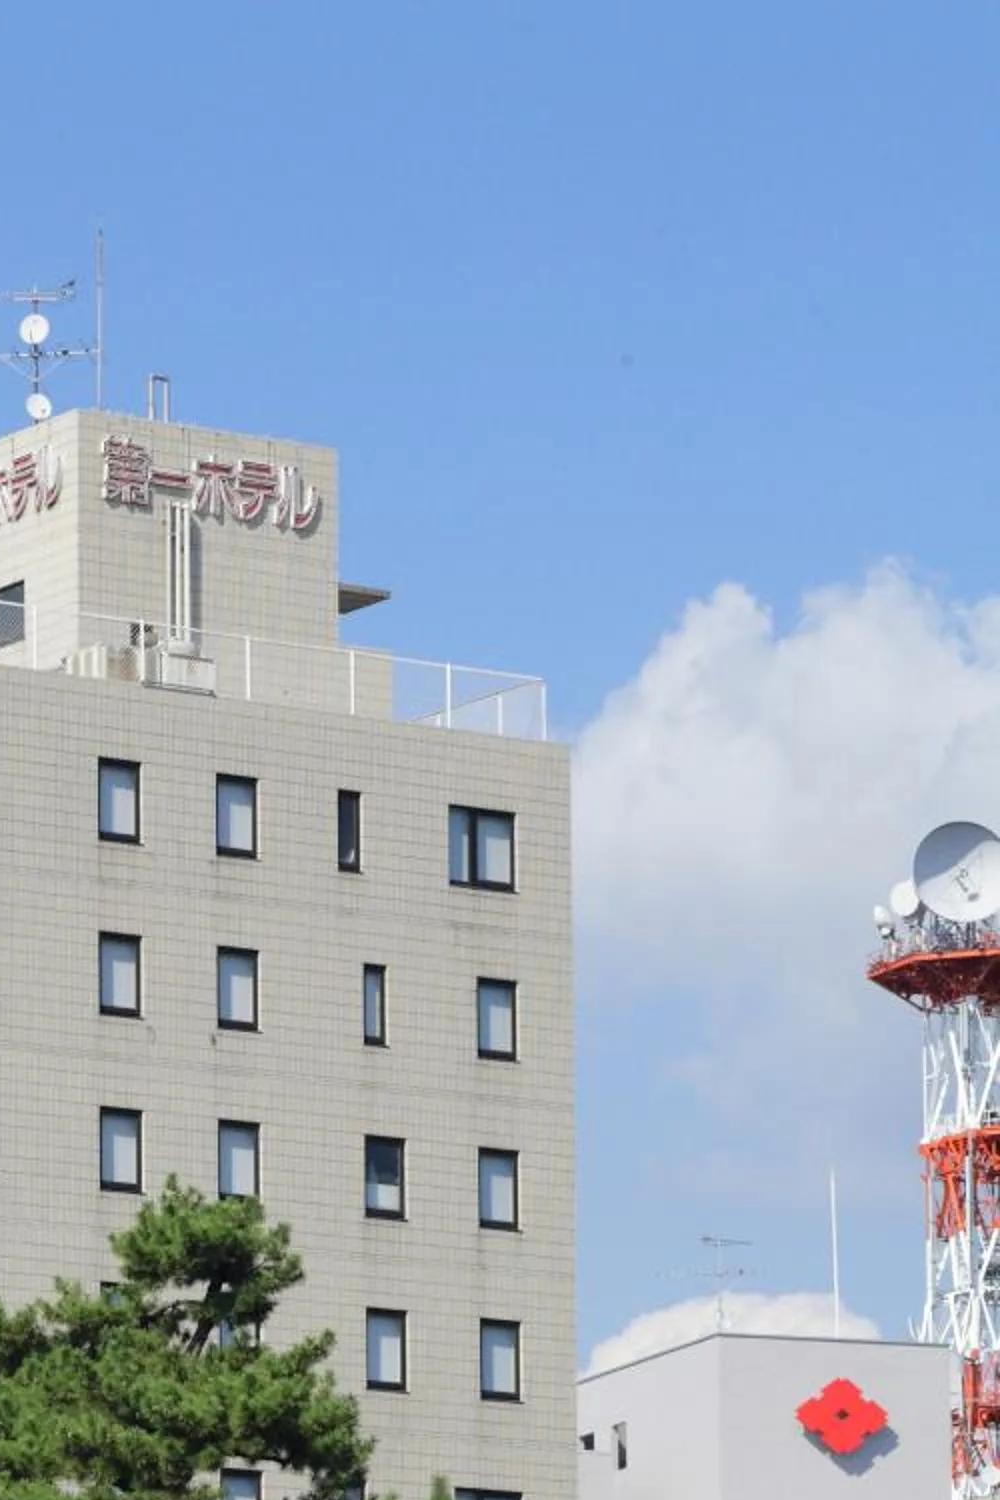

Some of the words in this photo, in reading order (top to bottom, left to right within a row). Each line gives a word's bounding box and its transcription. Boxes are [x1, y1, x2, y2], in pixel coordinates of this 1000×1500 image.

[101, 434, 320, 530] 第一ホテル
